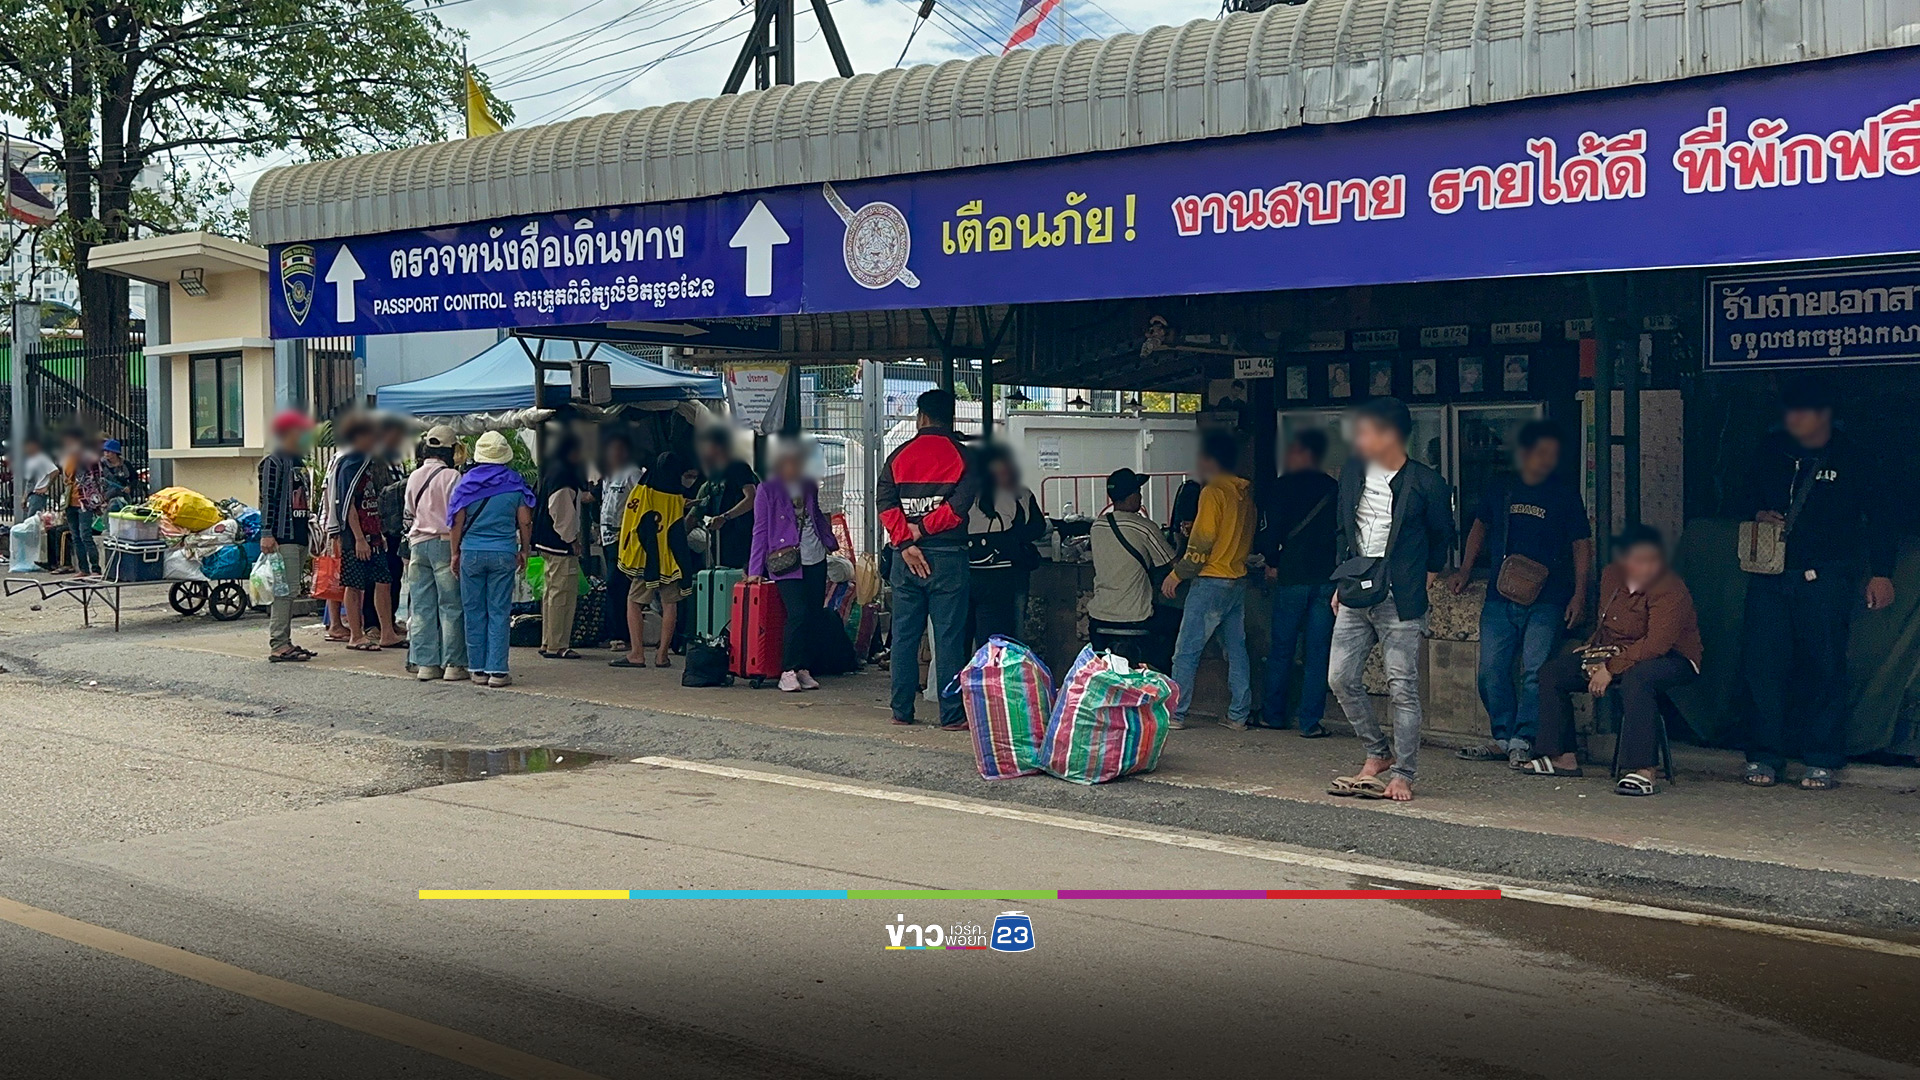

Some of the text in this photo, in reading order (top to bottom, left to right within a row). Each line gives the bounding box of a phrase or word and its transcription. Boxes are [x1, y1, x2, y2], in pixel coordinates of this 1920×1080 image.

[1172, 173, 1406, 236] งานสบาย
[1429, 129, 1647, 214] รายได้ดี
[389, 217, 686, 279] ตรวจหนังสือเดินทาง
[373, 296, 440, 315] PASSPORT
[444, 292, 508, 311] CONTROL
